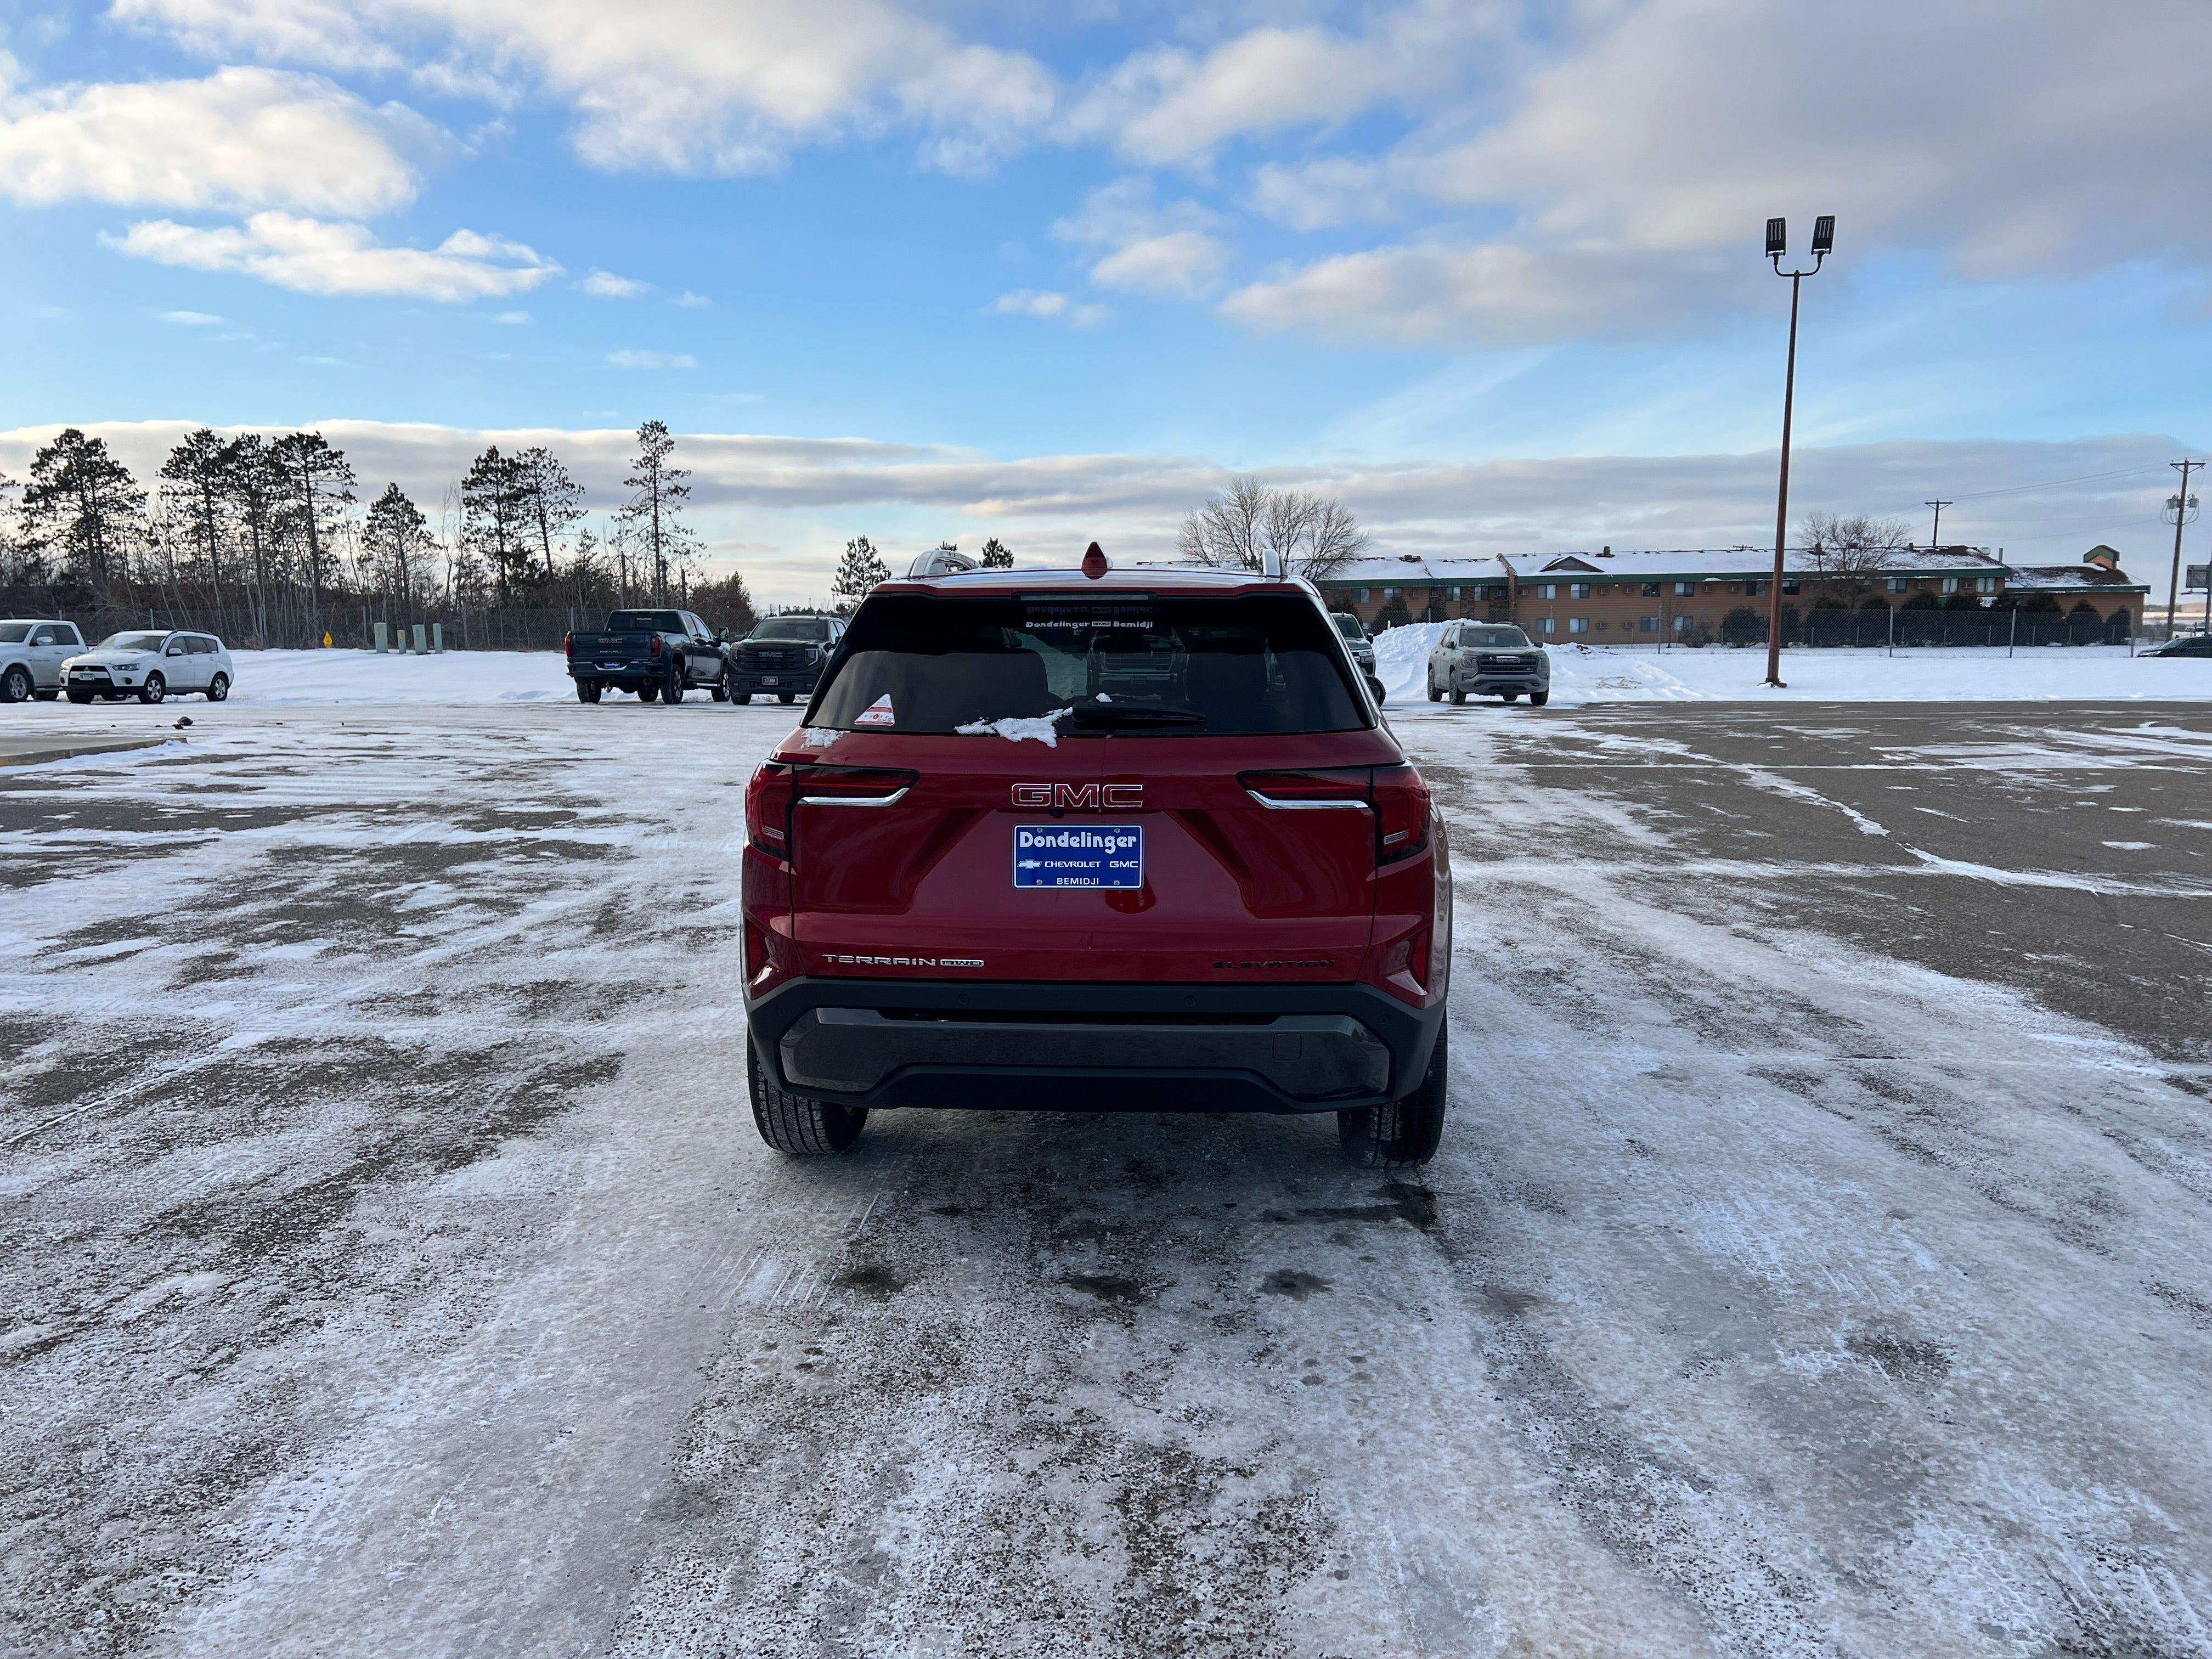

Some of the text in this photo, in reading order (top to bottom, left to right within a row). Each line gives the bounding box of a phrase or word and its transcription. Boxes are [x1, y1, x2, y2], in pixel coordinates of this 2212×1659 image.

[1012, 783, 1143, 808] GMC
[1019, 831, 1137, 854] Dondelinger
[821, 954, 936, 966] TERRAIN
[1212, 960, 1336, 968] ELEVATION
